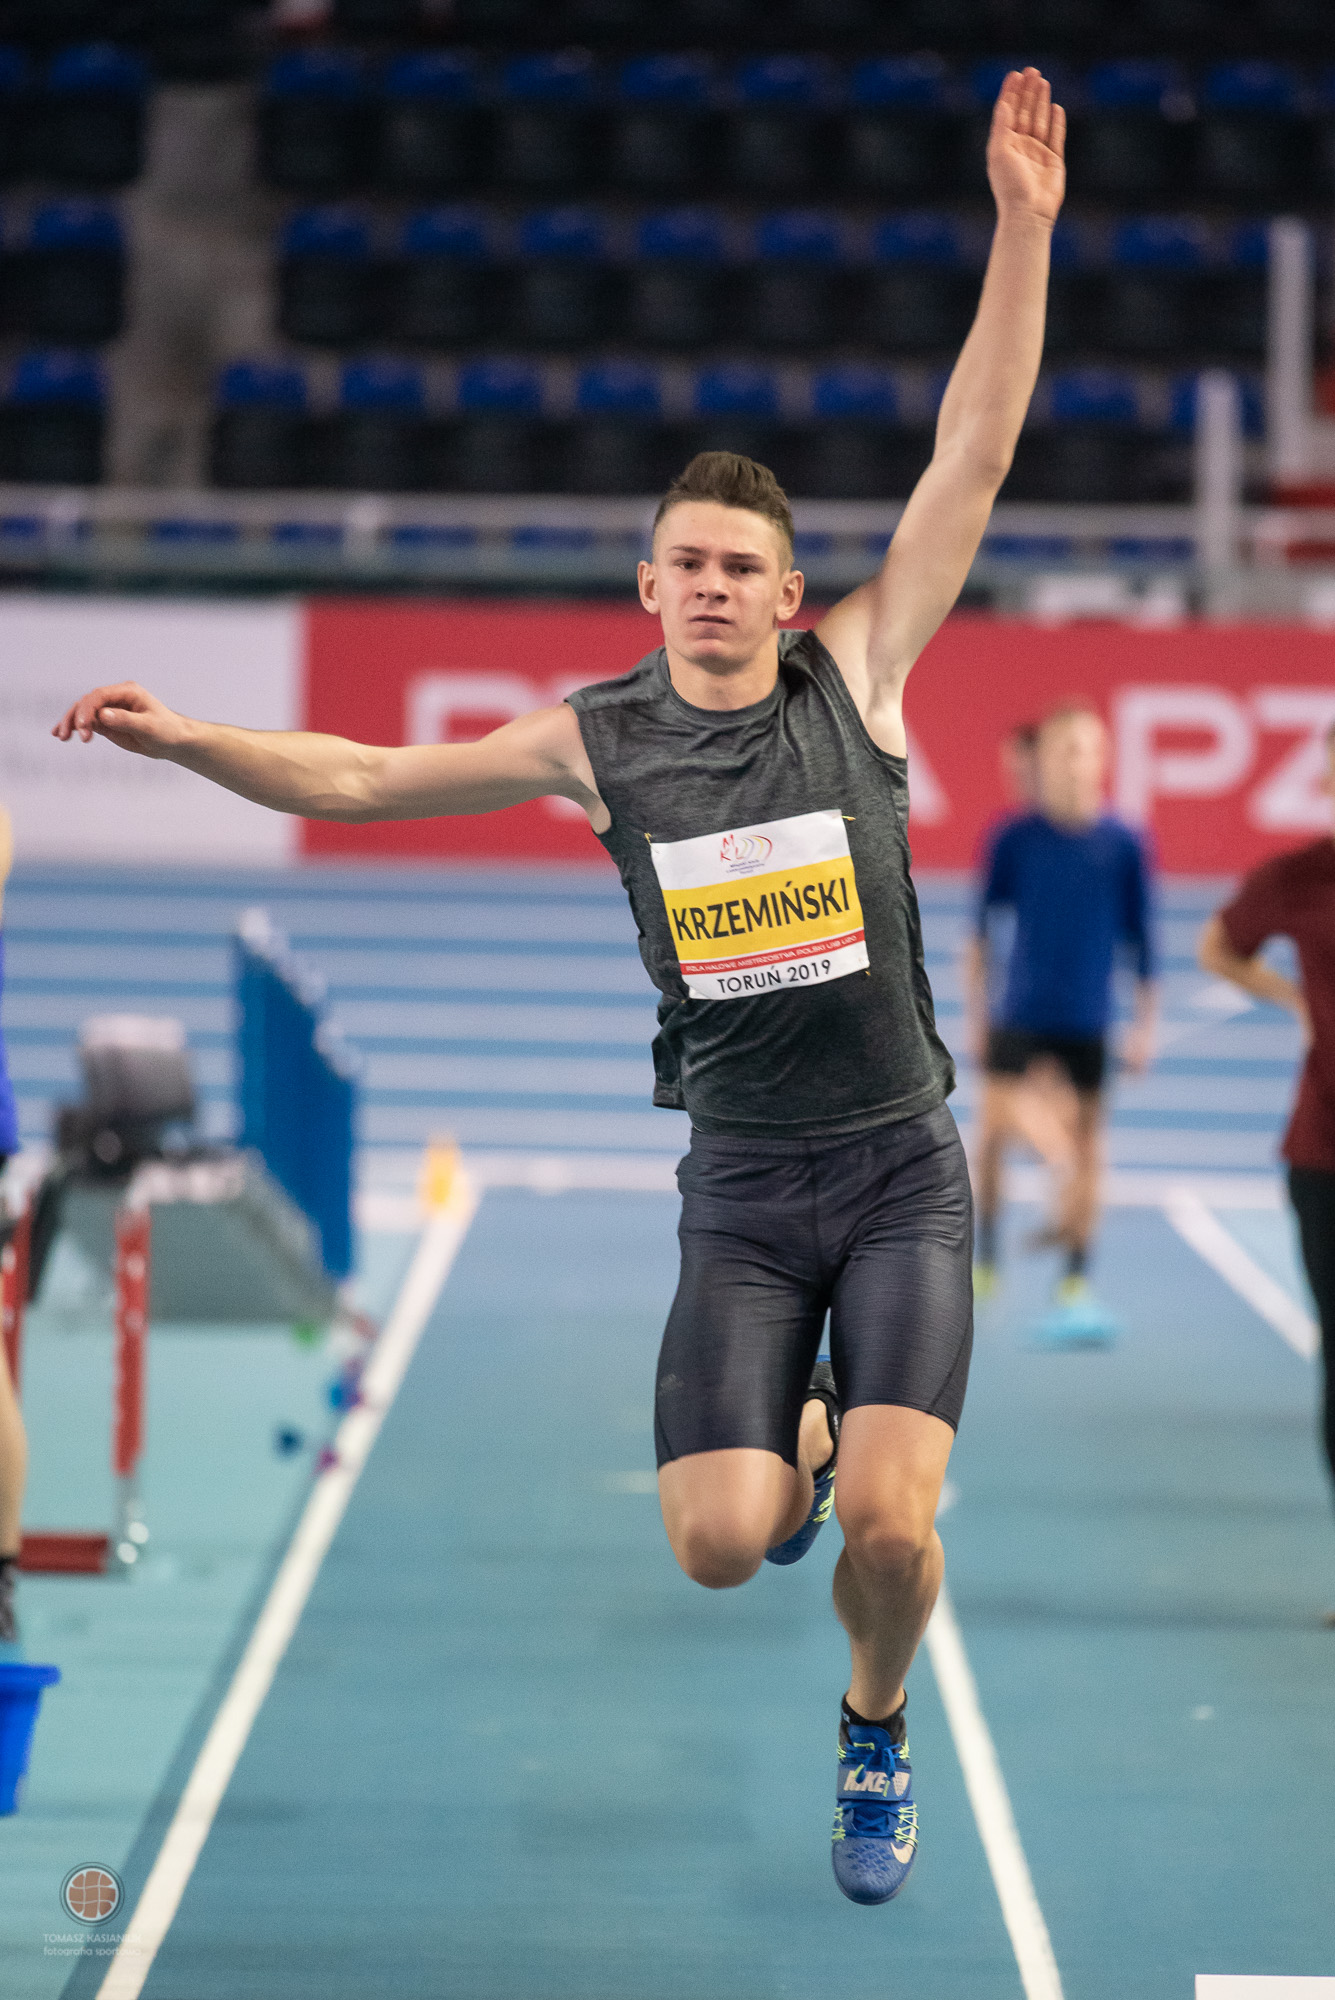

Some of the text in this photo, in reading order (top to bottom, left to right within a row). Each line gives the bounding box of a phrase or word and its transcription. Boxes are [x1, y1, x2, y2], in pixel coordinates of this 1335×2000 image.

[671, 878, 850, 941] KRZEMIŃSKI
[717, 959, 831, 993] TORUŃ 2019
